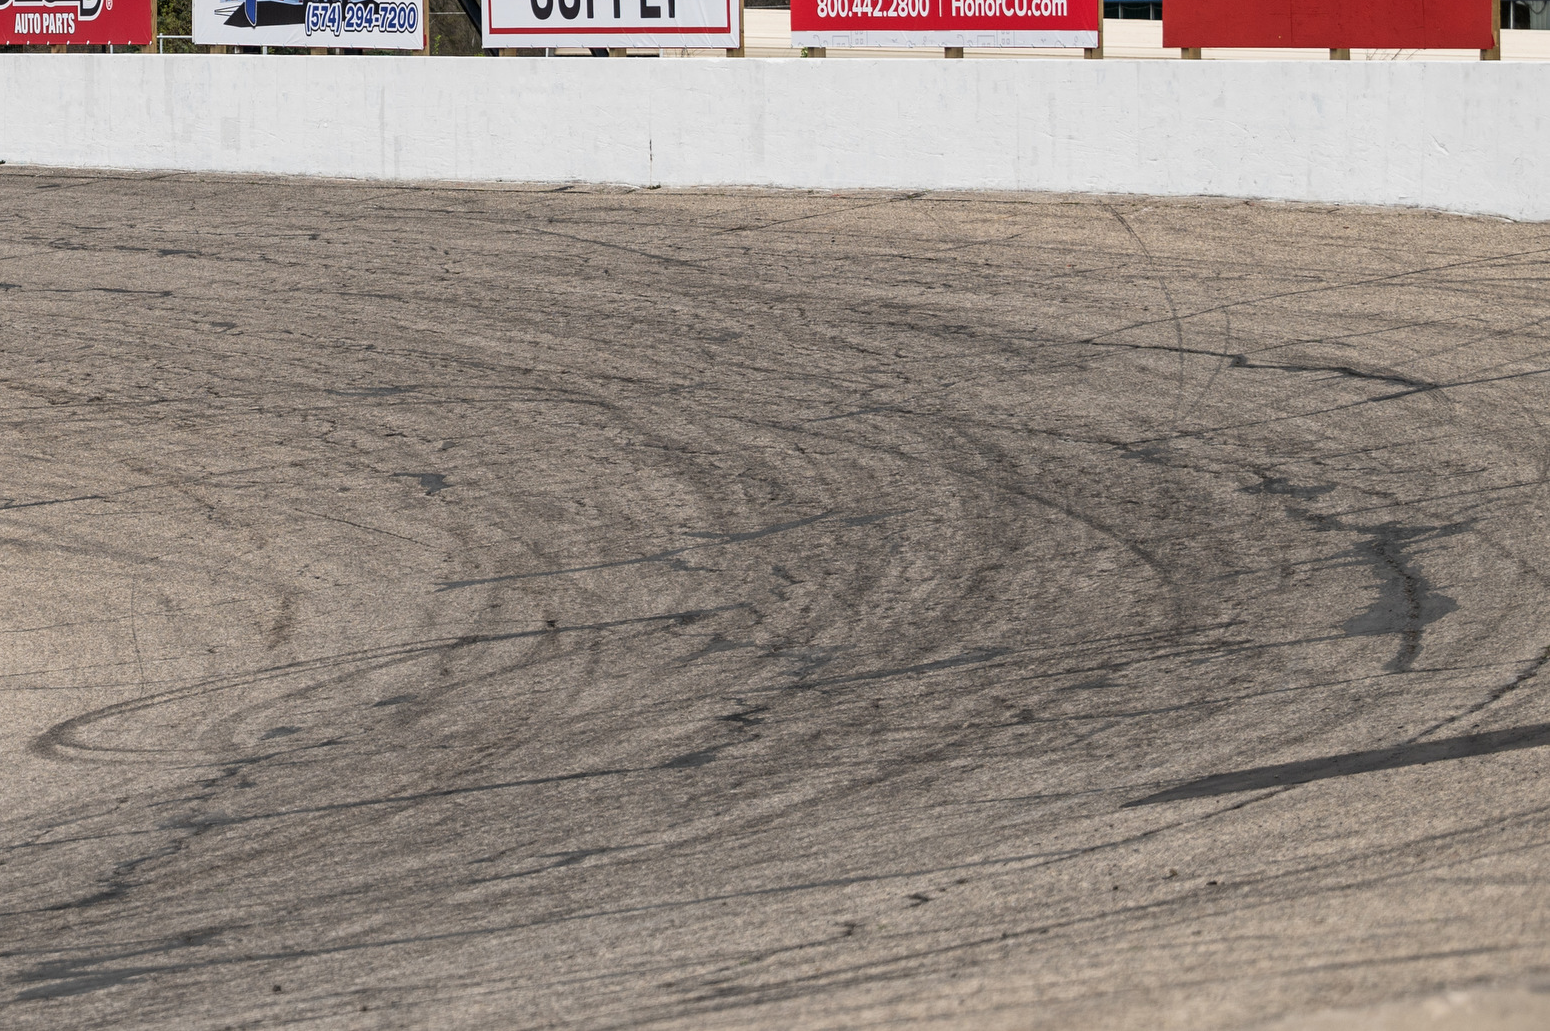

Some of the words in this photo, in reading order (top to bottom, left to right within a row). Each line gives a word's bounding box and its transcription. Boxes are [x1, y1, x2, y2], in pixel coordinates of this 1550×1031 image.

[14, 12, 41, 34] AUTO
[42, 12, 76, 34] PARTS
[306, 3, 342, 34] (574)
[345, 3, 417, 32] 294-7200
